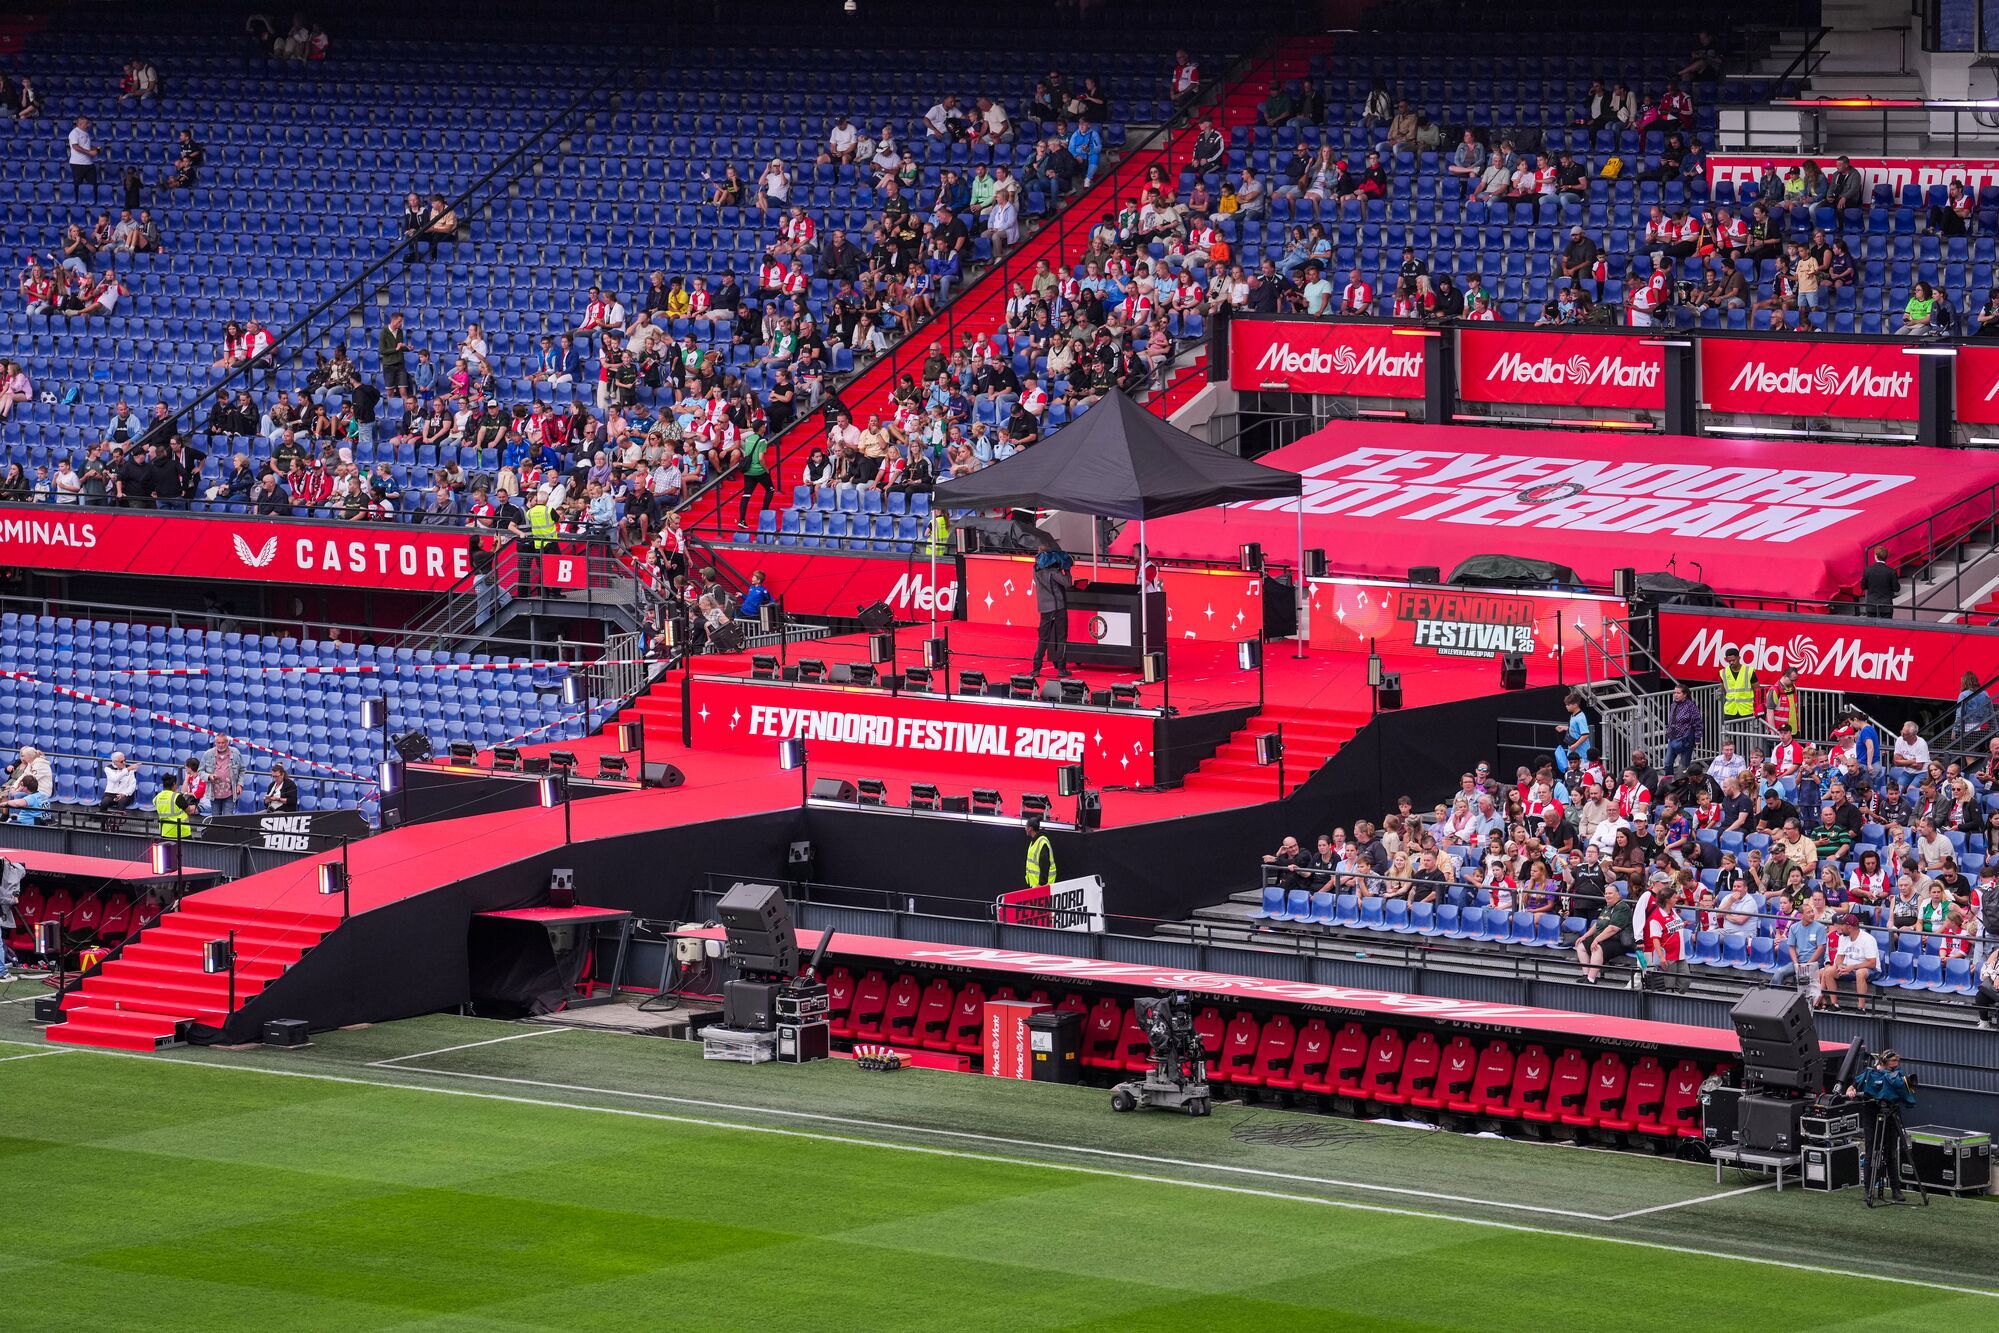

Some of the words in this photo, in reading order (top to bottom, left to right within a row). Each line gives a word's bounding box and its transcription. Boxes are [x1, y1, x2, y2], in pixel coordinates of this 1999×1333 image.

[1256, 342, 1332, 374] Media
[1352, 346, 1424, 378] Markt
[1486, 352, 1566, 384] Media
[1585, 355, 1661, 388] Markt
[1729, 361, 1813, 394] Media
[1834, 365, 1913, 398] Markt
[1301, 447, 1915, 507] FEYENOORD
[0, 519, 97, 548] MINALS
[296, 538, 469, 579] CASTORE
[557, 559, 573, 583] B
[1401, 592, 1534, 626] FEYENOORD
[1414, 619, 1517, 653] FESTIVAL
[1515, 626, 1532, 640] 20
[1518, 639, 1535, 653] 26
[1814, 637, 1914, 682] Markt
[749, 705, 894, 747] FEYENOORD
[895, 717, 1010, 757] FESTIVAL
[1014, 727, 1086, 763] 2026
[260, 815, 312, 835] SINCE
